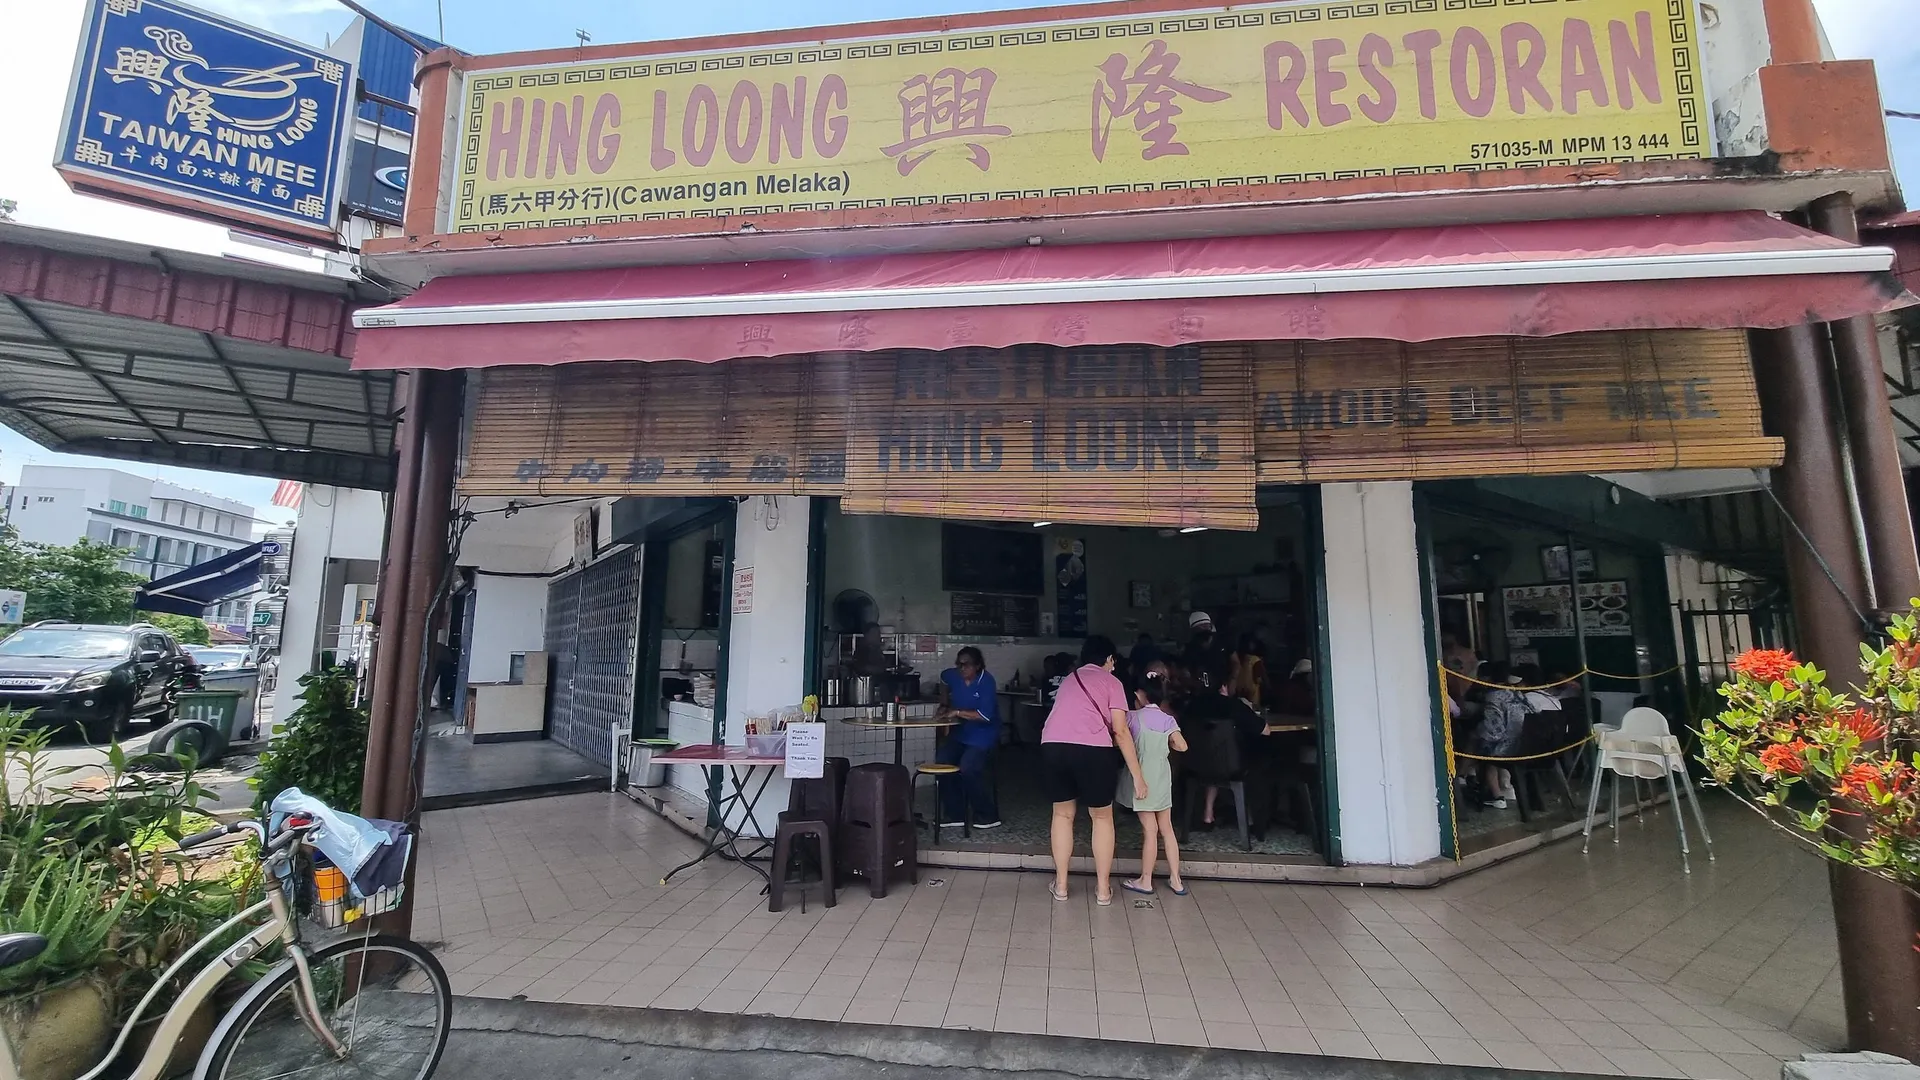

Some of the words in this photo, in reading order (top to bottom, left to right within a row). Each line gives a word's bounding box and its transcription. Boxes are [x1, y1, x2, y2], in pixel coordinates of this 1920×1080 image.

[104, 47, 236, 136] 興隆
[486, 92, 622, 182] HING
[649, 73, 849, 172] LOONG
[1263, 10, 1663, 131] RESTORAN
[98, 111, 239, 168] TAIWAN
[247, 153, 317, 188] MEE
[216, 126, 274, 149] HING
[275, 97, 319, 147] LOONG
[1470, 139, 1553, 160] 571035-M
[1562, 136, 1606, 154] MPM
[1611, 134, 1633, 152] 13
[1637, 133, 1670, 150] 444
[756, 170, 851, 196] Melaka)
[878, 410, 1004, 473] HING
[1031, 405, 1220, 473] LOONG
[1256, 386, 1429, 432] AMOUS
